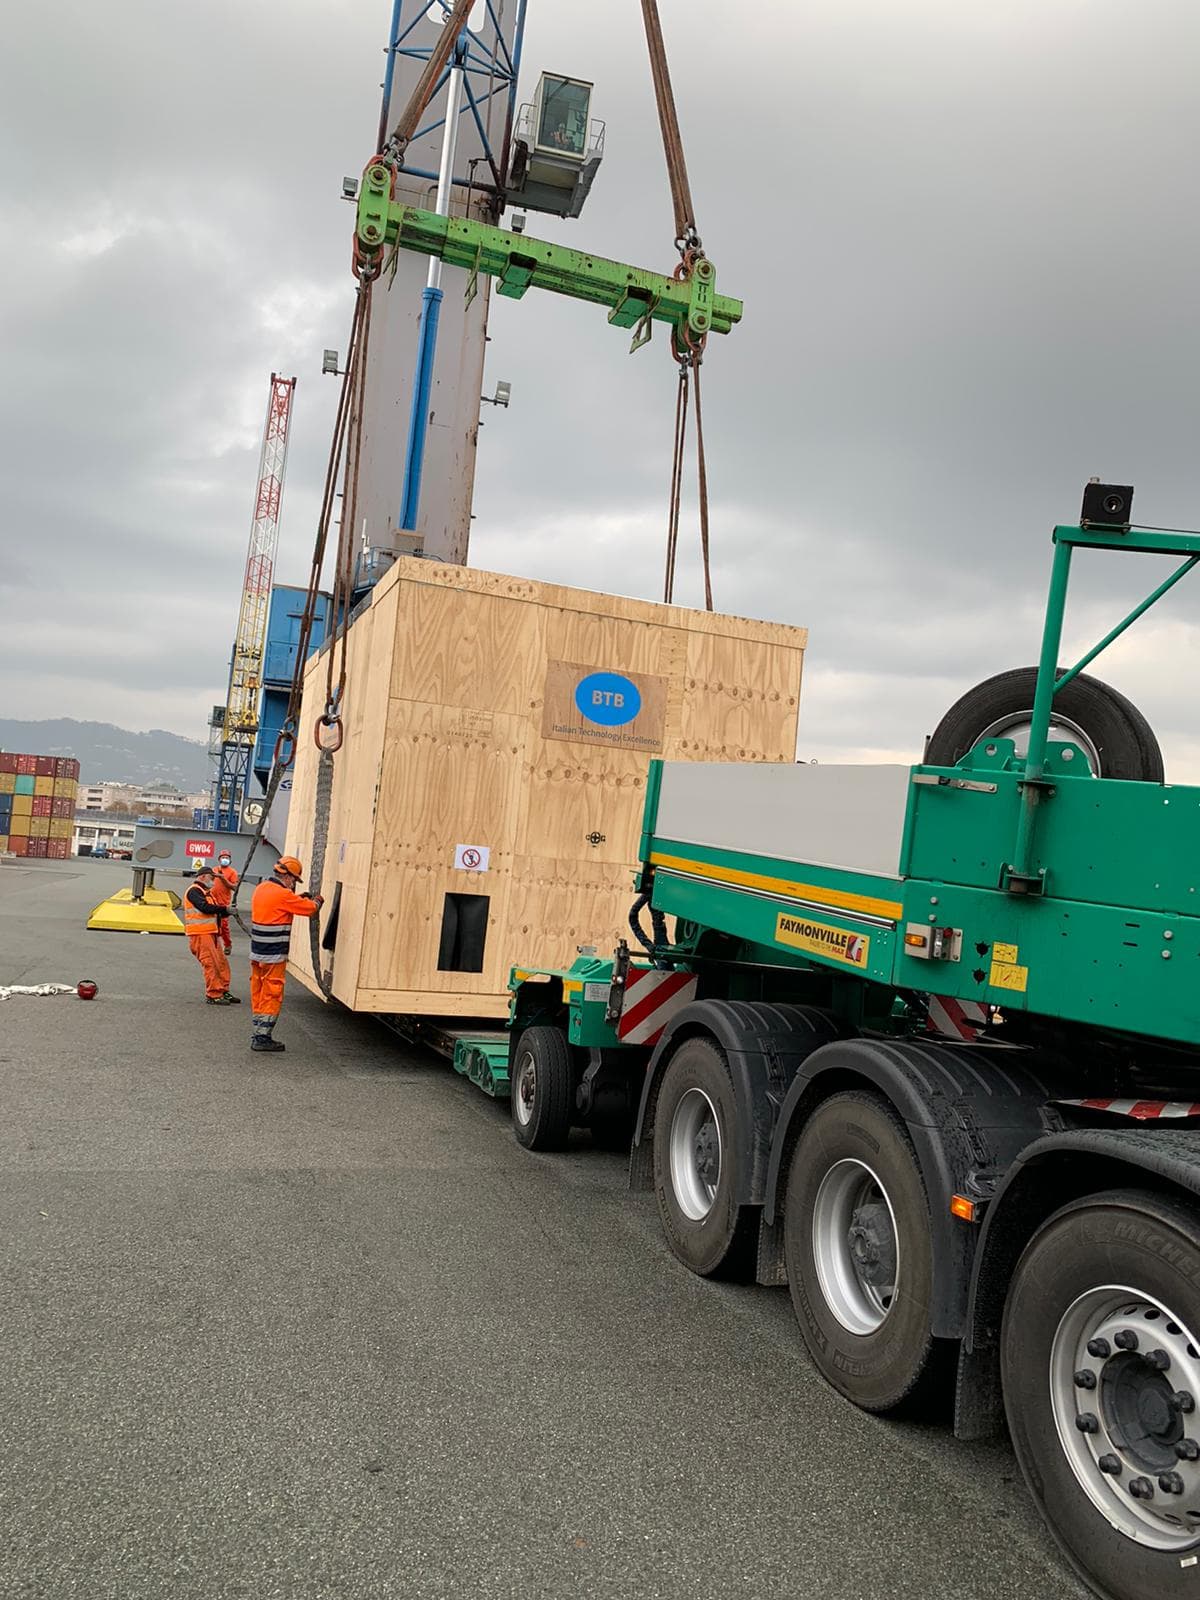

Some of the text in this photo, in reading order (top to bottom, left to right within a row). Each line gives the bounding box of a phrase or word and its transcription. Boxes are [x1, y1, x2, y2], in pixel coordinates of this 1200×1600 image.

[591, 690, 625, 708] BTB
[552, 723, 661, 746] Italian Technology Excellence
[780, 918, 847, 947] FAYMONVILLE
